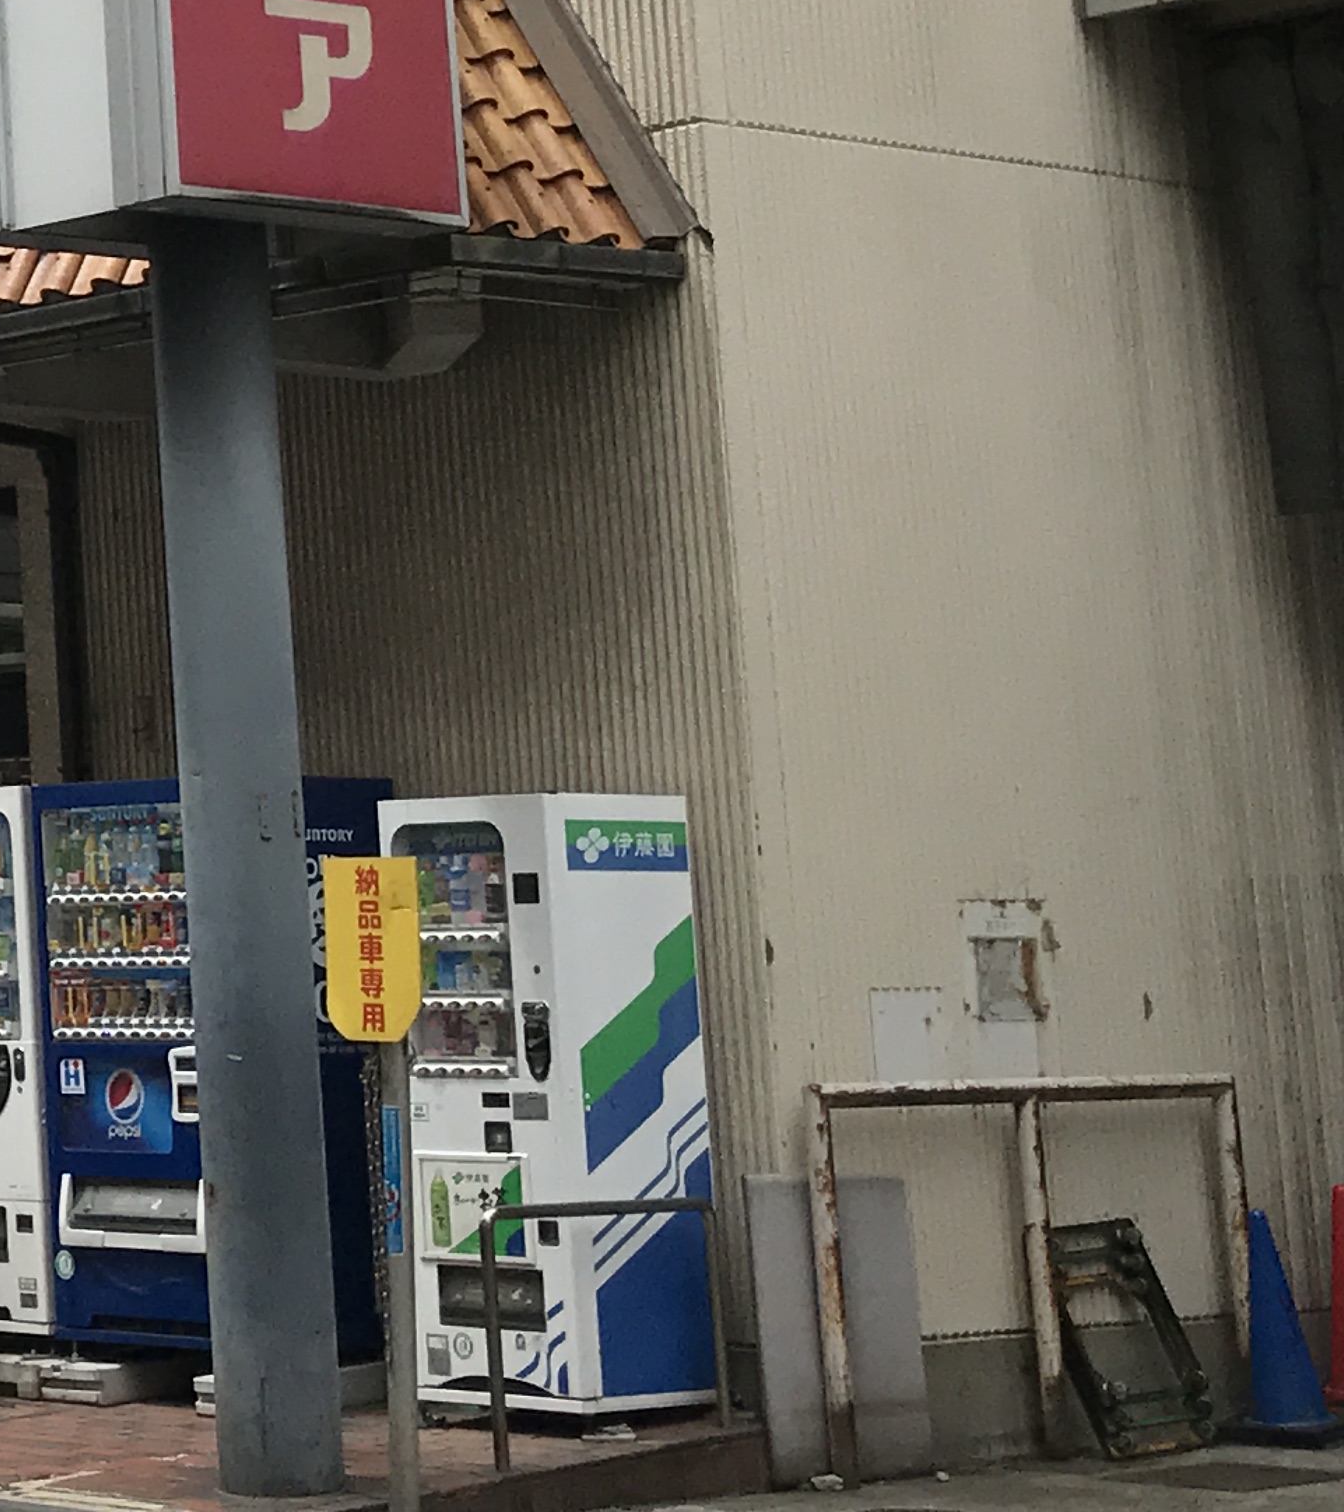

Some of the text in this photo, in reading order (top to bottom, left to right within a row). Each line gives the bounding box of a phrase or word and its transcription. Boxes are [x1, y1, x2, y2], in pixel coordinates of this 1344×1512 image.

[305, 827, 355, 843] UNTORY
[612, 831, 675, 858] 伊藤園
[354, 863, 386, 1034] 納品車専用
[107, 1122, 142, 1141] pepsi
